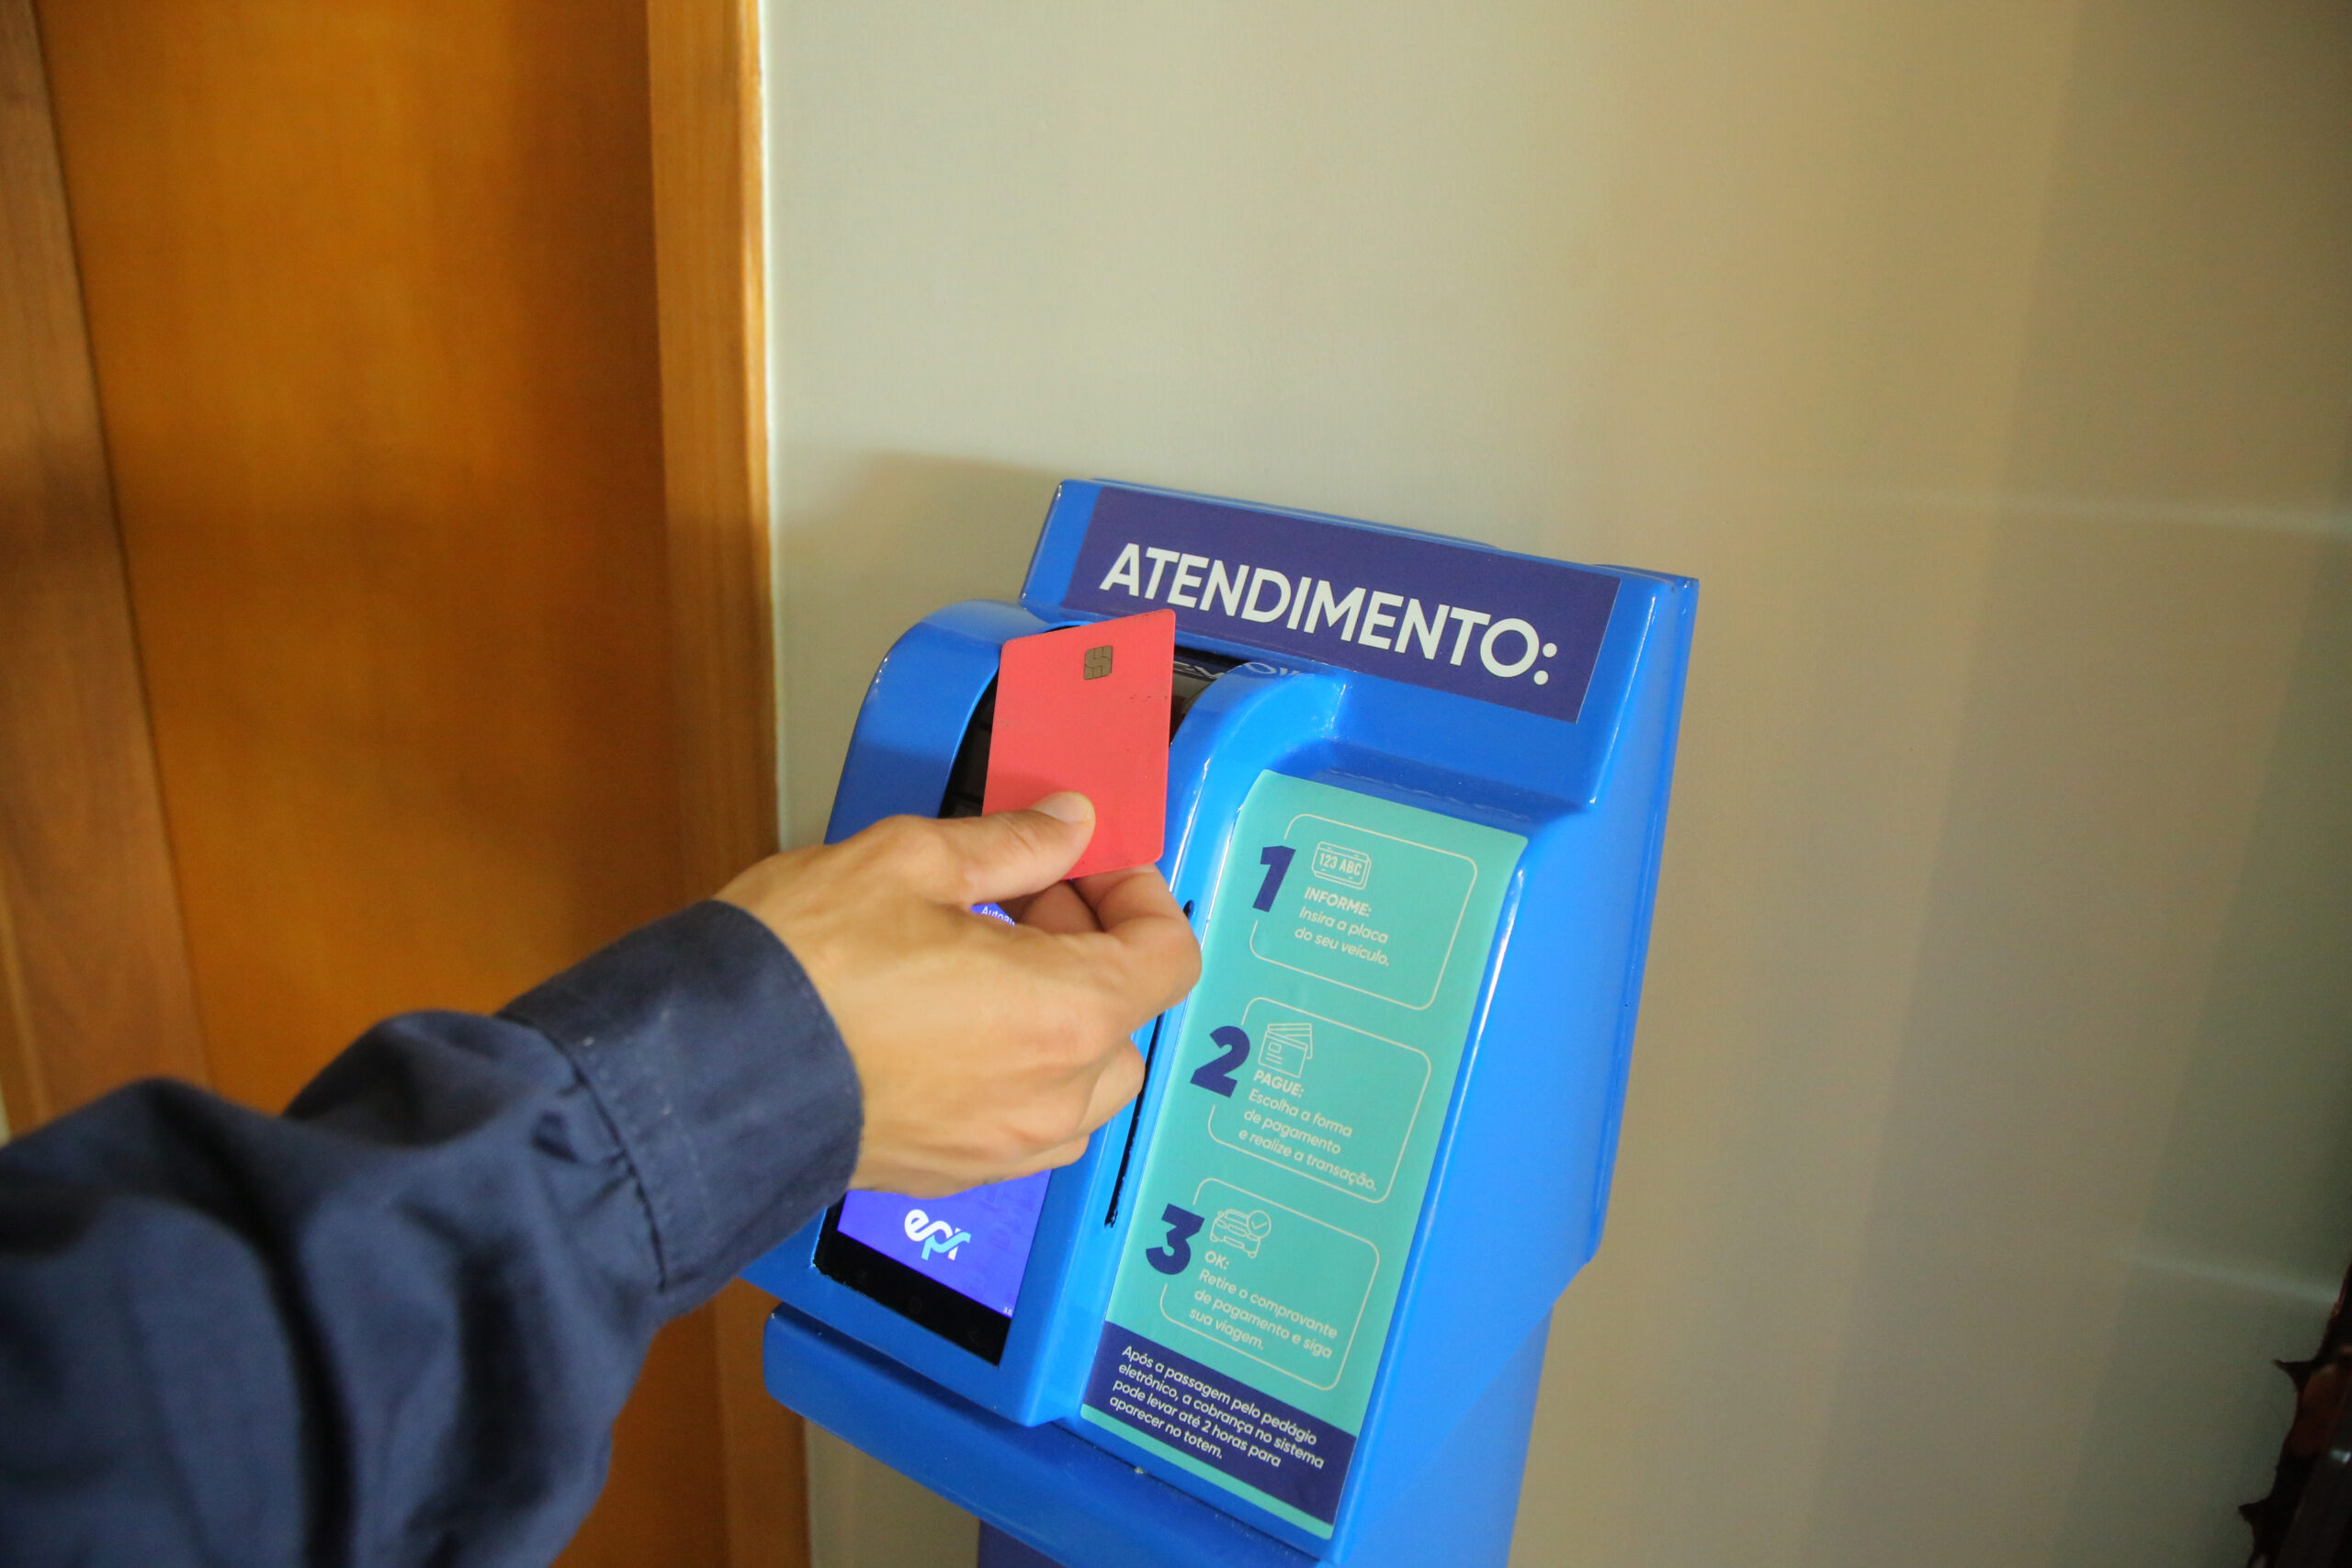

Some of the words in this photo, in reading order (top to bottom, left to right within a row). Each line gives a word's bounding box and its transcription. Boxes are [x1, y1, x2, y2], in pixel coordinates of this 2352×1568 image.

[1099, 542, 1558, 685] ATENDIMENTO:
[1252, 845, 1296, 912] 1
[1319, 852, 1338, 870] 123
[1339, 858, 1363, 876] ABC
[1299, 906, 1334, 928] Insira
[1338, 921, 1347, 931] a
[1347, 923, 1389, 944] placa
[1304, 886, 1372, 917] INFORME:
[1295, 927, 1313, 942] do
[1315, 933, 1339, 950] seu
[1341, 942, 1390, 967] veículo.
[1190, 1025, 1250, 1099] 2
[1253, 1069, 1305, 1098] PAGUE:
[1244, 1109, 1262, 1124] de
[1261, 1117, 1341, 1155] pagamento
[1249, 1089, 1299, 1118] Escolha
[1301, 1111, 1310, 1122] a
[1313, 1112, 1353, 1138] forma
[1238, 1129, 1248, 1140] e
[1250, 1132, 1293, 1157] realize
[1295, 1151, 1304, 1161] a
[1306, 1154, 1377, 1191] transação.
[1146, 1203, 1205, 1276] 3
[1204, 1250, 1230, 1270] OK:
[1189, 1308, 1213, 1326] sua
[1215, 1318, 1264, 1350] viagem.
[1194, 1289, 1212, 1304] de
[1213, 1298, 1290, 1338] pagamento
[1292, 1334, 1301, 1345] e
[1303, 1337, 1333, 1359] siga
[1199, 1269, 1237, 1294] Retire
[1238, 1289, 1249, 1299] o
[1250, 1293, 1338, 1339] comprovante
[1113, 1379, 1146, 1402] pode
[1147, 1391, 1178, 1417] levar
[1179, 1410, 1201, 1428] até
[1201, 1420, 1210, 1433] 2
[1211, 1424, 1249, 1451] horas
[1248, 1445, 1282, 1467] para
[1118, 1363, 1180, 1402] eletrônico,
[1182, 1394, 1192, 1405] a
[1193, 1396, 1254, 1435] cobrança
[1254, 1427, 1272, 1444] no
[1273, 1437, 1325, 1470] sistema
[1122, 1345, 1153, 1369] Após
[1155, 1361, 1165, 1372] a
[1164, 1367, 1231, 1405] passagem
[1230, 1398, 1261, 1418] pelo
[1262, 1412, 1317, 1446] pedágio
[1109, 1395, 1165, 1429] aparecer
[1165, 1423, 1182, 1438] no
[1183, 1429, 1223, 1460] totem.
